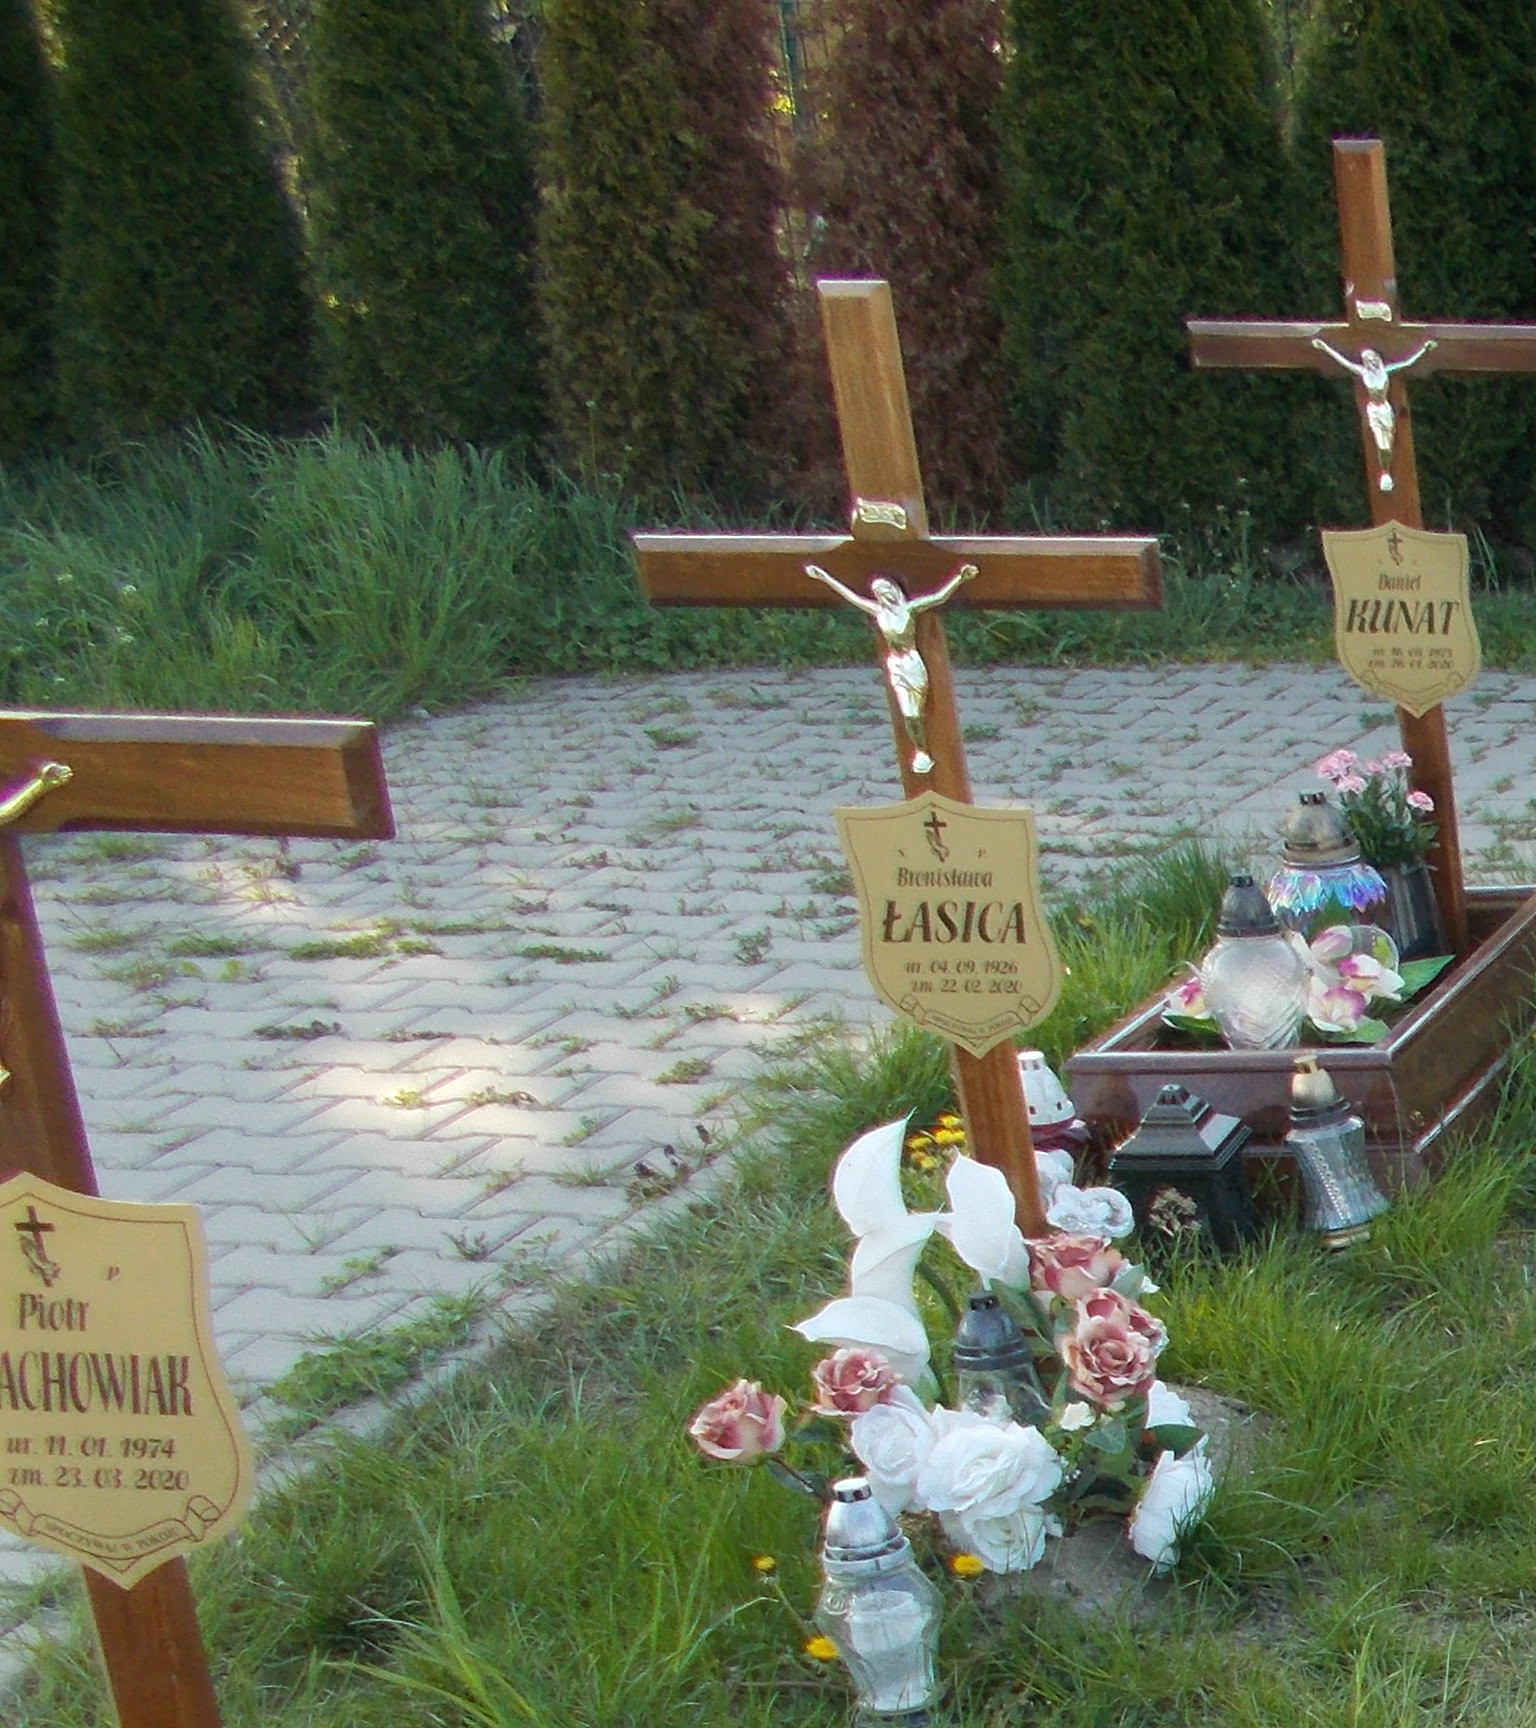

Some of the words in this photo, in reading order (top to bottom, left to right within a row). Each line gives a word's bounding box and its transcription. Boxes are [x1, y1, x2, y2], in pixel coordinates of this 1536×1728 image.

[1346, 599, 1460, 635] KUNAT
[897, 867, 993, 888] Bronisława
[882, 900, 1027, 944] ŁASICA
[18, 1293, 90, 1333] Piotr
[120, 1437, 175, 1459] 1974
[134, 1468, 190, 1490] 2020
